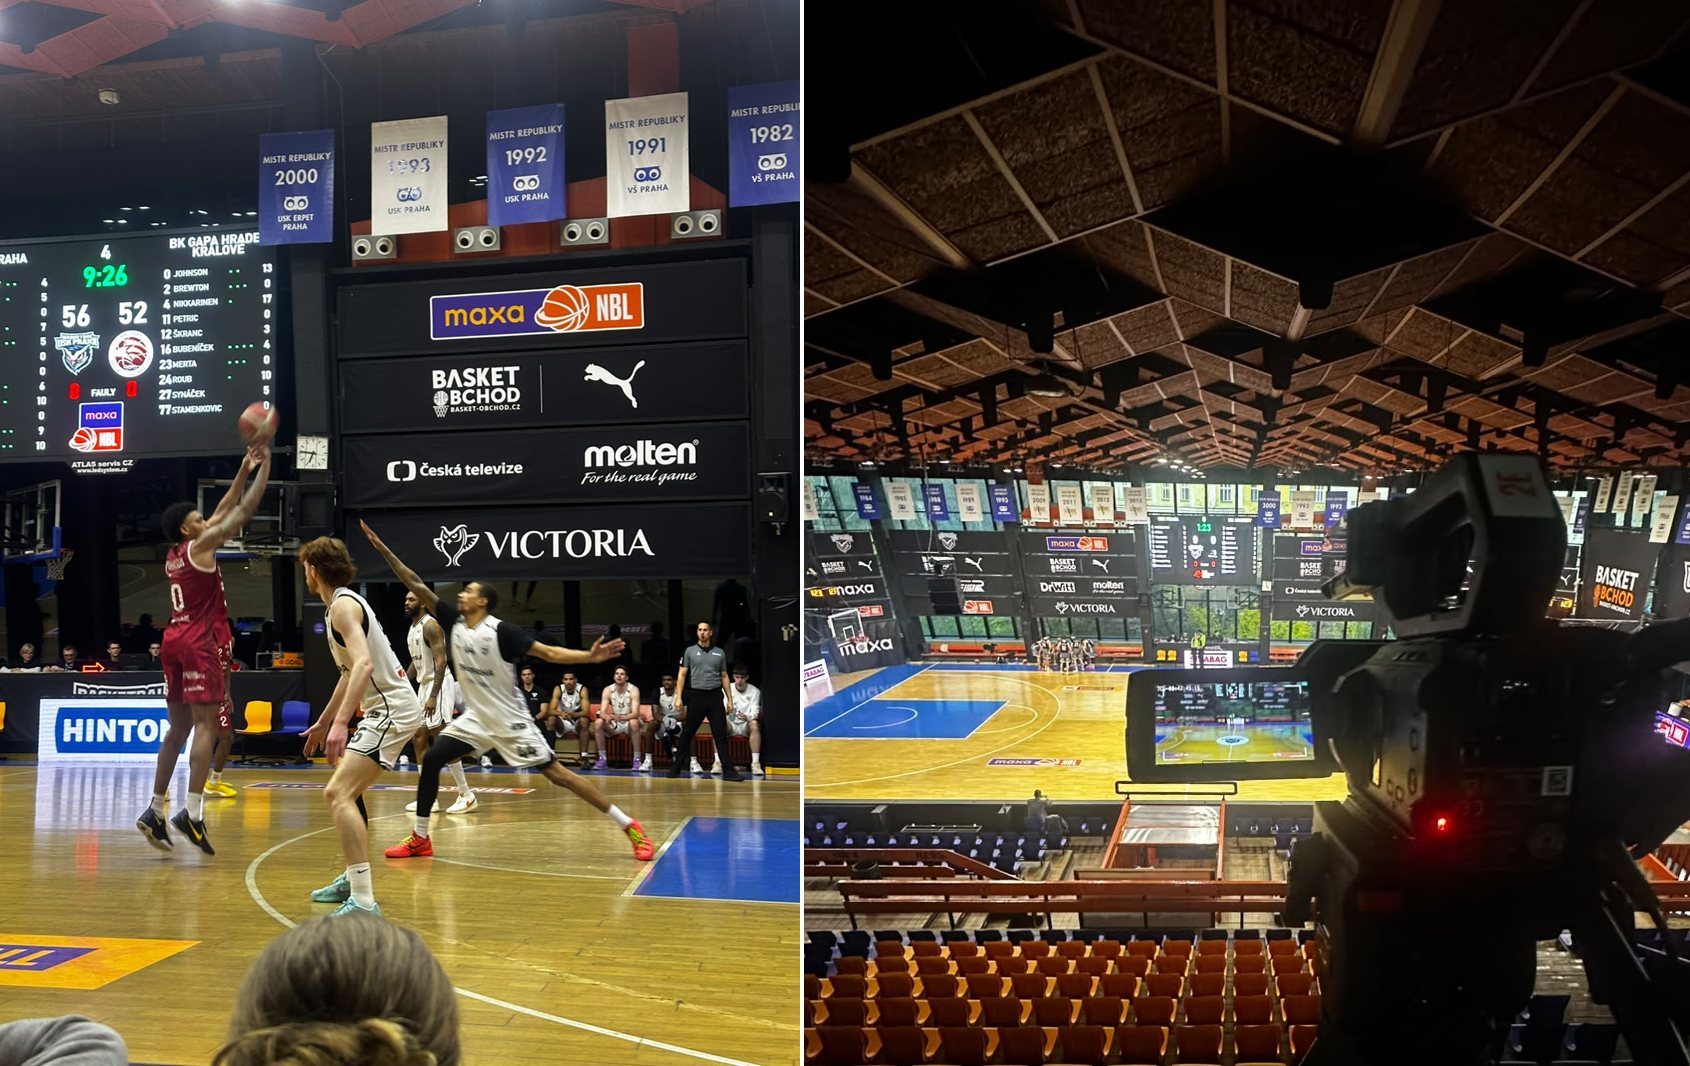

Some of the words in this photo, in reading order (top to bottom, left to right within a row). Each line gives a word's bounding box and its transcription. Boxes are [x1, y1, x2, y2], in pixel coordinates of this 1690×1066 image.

[731, 106, 758, 117] MISTR
[609, 120, 635, 130] MISTR
[638, 114, 686, 128] REPUBLIKY
[490, 130, 514, 140] MISTR
[517, 124, 562, 138] REPUBLIKY
[750, 124, 793, 144] 1982
[374, 145, 398, 153] MISTR
[401, 140, 444, 151] REPUBLIKY
[628, 138, 666, 156] 1991
[263, 155, 286, 164] MISTR
[289, 152, 331, 163] REPUBLIKY
[506, 146, 547, 166] 1992
[388, 157, 431, 175] 1993
[274, 168, 318, 186] 2000
[752, 174, 762, 182] VŠ
[765, 172, 795, 182] PRAHA
[628, 184, 638, 194] VŠ
[640, 184, 668, 192] PRAHA
[505, 195, 519, 203] USK
[522, 192, 549, 202] PRAHA
[404, 205, 430, 213] PRAHA
[278, 214, 291, 222] USK
[282, 222, 308, 230] PRAHA
[169, 237, 186, 249] BK
[188, 235, 219, 247] GAPA
[221, 232, 260, 245] HRADE
[0, 252, 28, 264] RAHA
[101, 245, 111, 259] 4
[83, 265, 128, 288] 9:26
[164, 269, 171, 279] 0
[173, 268, 208, 278] JOHNSON
[262, 263, 272, 273] 13
[41, 278, 48, 287] 4
[163, 285, 170, 294] 2
[173, 283, 209, 293] BREWTON
[264, 279, 270, 288] 0
[41, 293, 48, 302] 5
[163, 299, 170, 310] 4
[173, 298, 218, 308] NIKKARINEN
[262, 294, 272, 303] 17
[41, 308, 47, 316] 0
[62, 304, 90, 328] 56
[119, 301, 147, 324] 52
[162, 314, 171, 324] 11
[173, 314, 199, 323] PETRIC
[264, 310, 270, 319] 0
[445, 305, 524, 326] maxa
[596, 294, 633, 321] NBL
[40, 322, 47, 331] 7
[161, 329, 172, 339] 12
[173, 328, 203, 338] ŠKRANC
[264, 325, 270, 334] 3
[40, 337, 46, 346] 5
[161, 344, 171, 354] 16
[173, 342, 214, 353] BUBENÍČEK
[263, 340, 270, 349] 4
[40, 352, 46, 361] 0
[159, 359, 172, 369] 23
[173, 360, 197, 368] MERTA
[264, 355, 270, 364] 0
[40, 367, 45, 376] 0
[159, 374, 172, 385] 24
[172, 375, 192, 384] ROUB
[261, 370, 272, 380] 10
[432, 366, 520, 388] BASKET
[39, 382, 45, 390] 6
[69, 383, 80, 399] 0
[91, 387, 116, 397] FAULY
[127, 380, 137, 397] 0
[159, 389, 172, 400] 27
[172, 388, 205, 399] SYNÁČEK
[263, 386, 269, 395] 5
[37, 397, 46, 405] 10
[159, 404, 172, 415] 77
[172, 404, 222, 414] STAMENKOVIC
[263, 401, 269, 410] 0
[38, 411, 44, 420] 0
[85, 411, 117, 420] maxa
[450, 404, 521, 413] BASKET-OBCHOD.CZ
[38, 426, 44, 435] 9
[35, 441, 45, 450] 10
[99, 432, 117, 447] NBL
[420, 462, 462, 476] Česká
[465, 463, 523, 476] televize
[581, 472, 602, 484] For
[604, 472, 626, 483] the
[628, 470, 657, 483] real
[658, 472, 698, 486] game
[484, 528, 655, 558] VICTORIA
[1596, 565, 1640, 591] BASKET
[171, 584, 184, 612] 0
[1070, 604, 1116, 613] VICTORIA
[1310, 607, 1355, 616] VICTORIA
[840, 638, 893, 656] maxa
[804, 667, 824, 678] TRABAG
